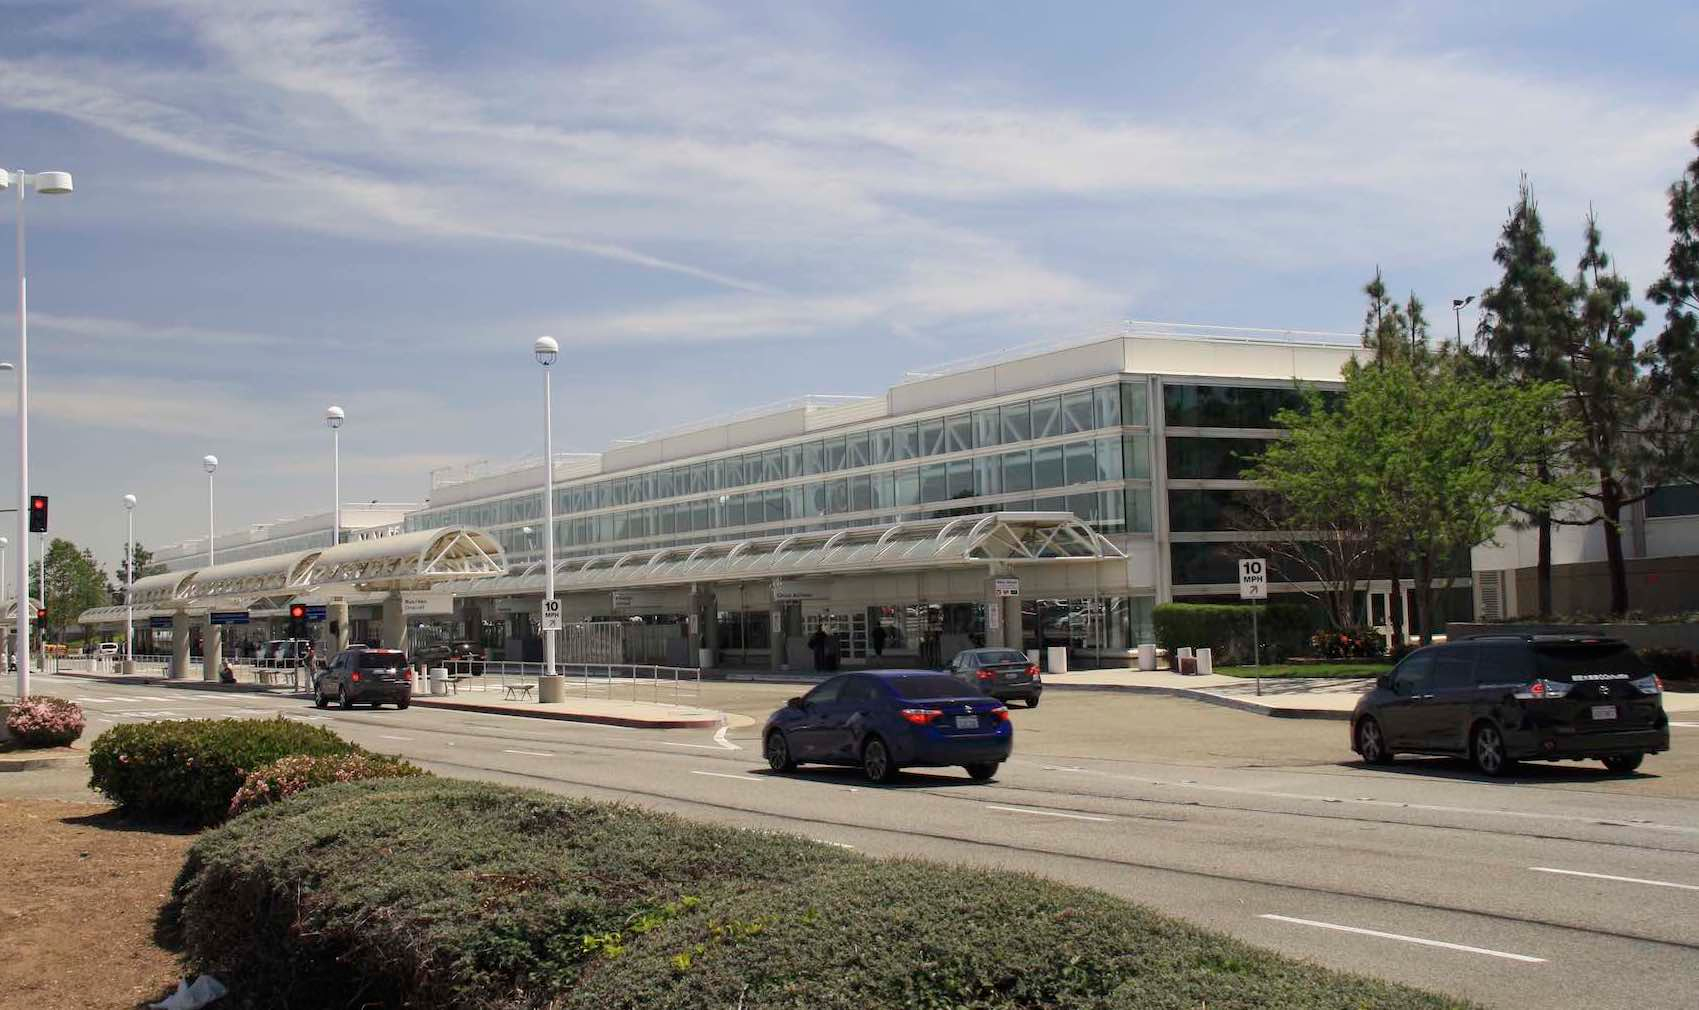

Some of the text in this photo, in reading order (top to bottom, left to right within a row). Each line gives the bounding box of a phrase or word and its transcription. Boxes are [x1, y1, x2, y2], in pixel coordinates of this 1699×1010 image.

[1243, 562, 1261, 574] 10
[1243, 575, 1263, 583] MPH
[545, 602, 558, 611] 10
